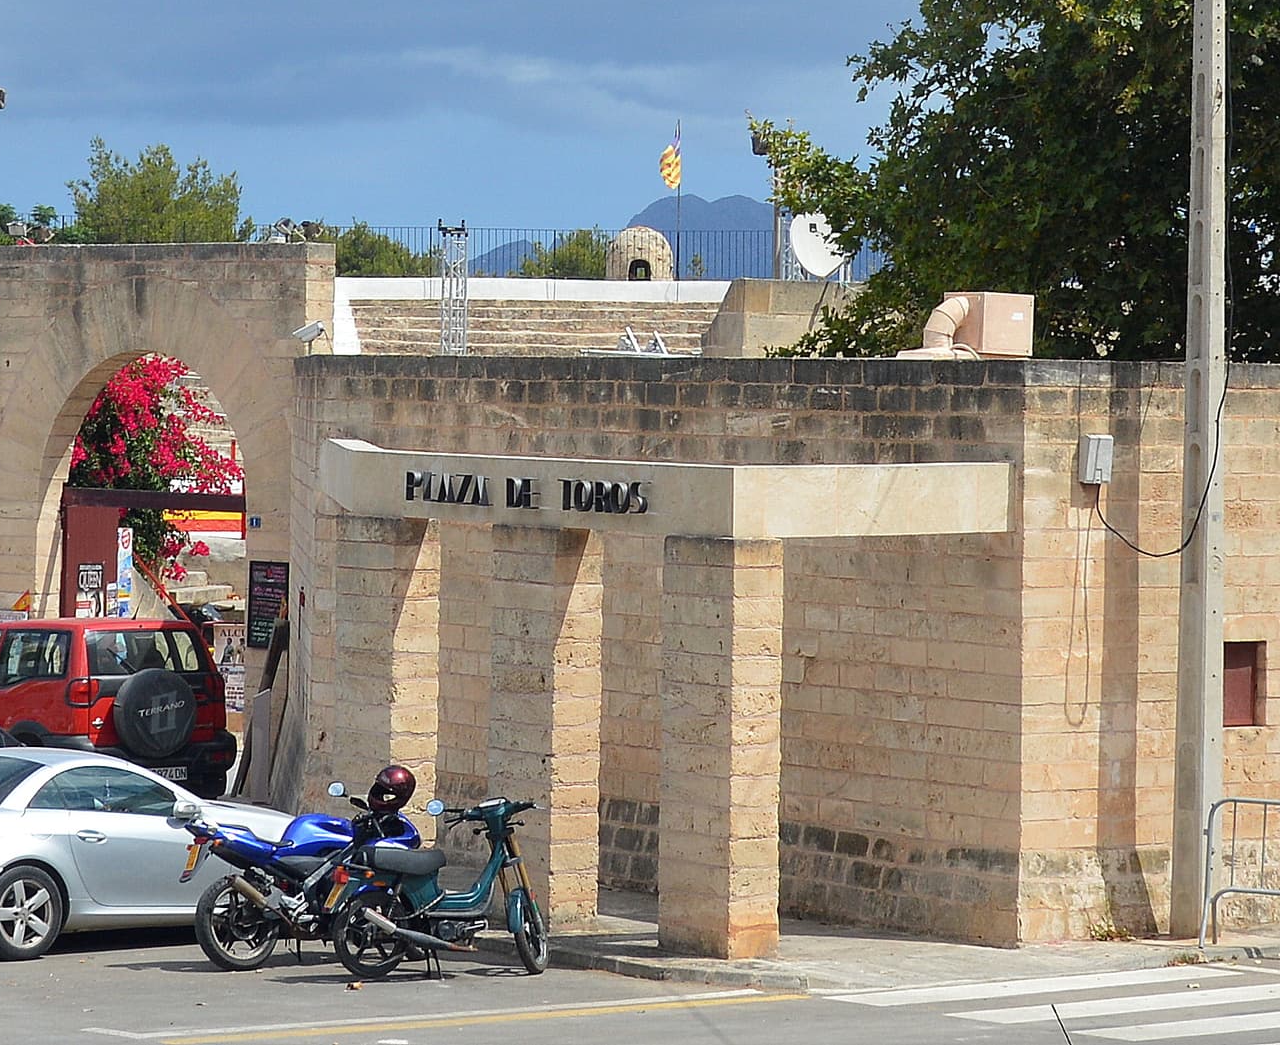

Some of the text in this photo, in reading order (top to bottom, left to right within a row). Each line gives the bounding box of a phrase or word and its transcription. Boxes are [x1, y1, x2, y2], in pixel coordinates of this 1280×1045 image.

[405, 470, 657, 515] PLAZA DE TOROS
[138, 700, 185, 717] TERRANO
